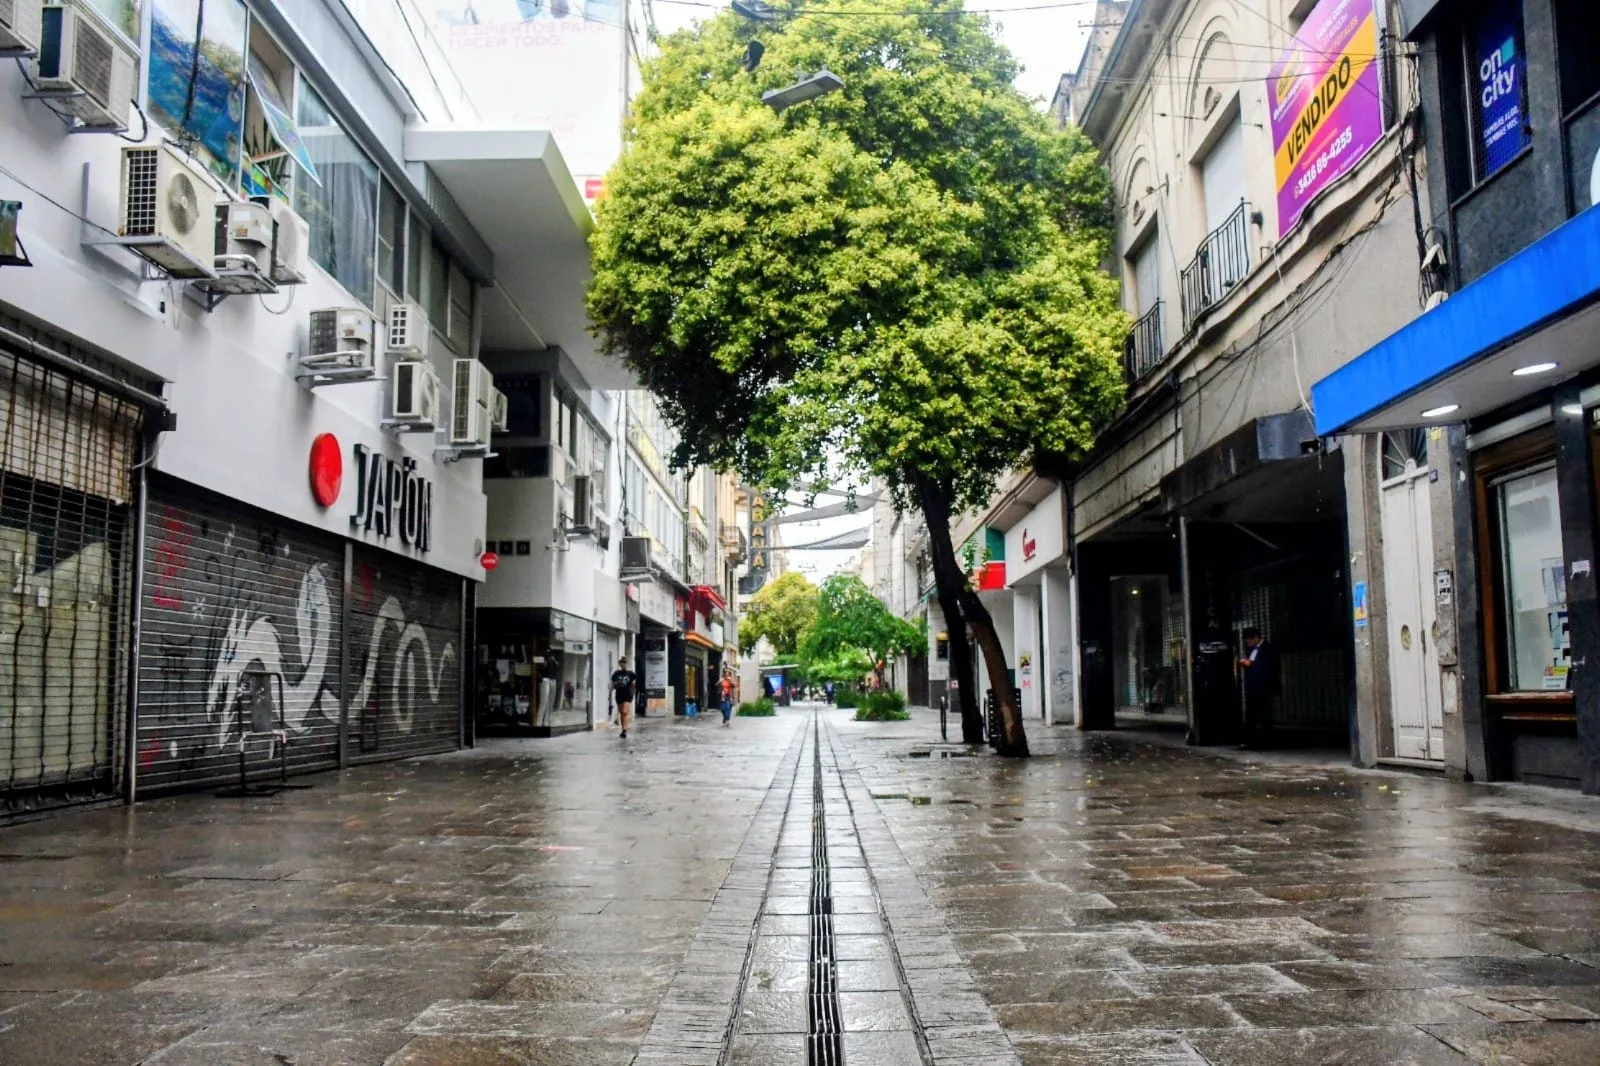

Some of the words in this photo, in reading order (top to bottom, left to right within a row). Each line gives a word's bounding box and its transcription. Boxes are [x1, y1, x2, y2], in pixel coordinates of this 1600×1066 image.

[449, 36, 507, 49] HACER
[1480, 49, 1502, 82] on
[1482, 64, 1516, 108] city
[1287, 56, 1351, 163] VENDIDO
[349, 443, 432, 552] JAPÖN
